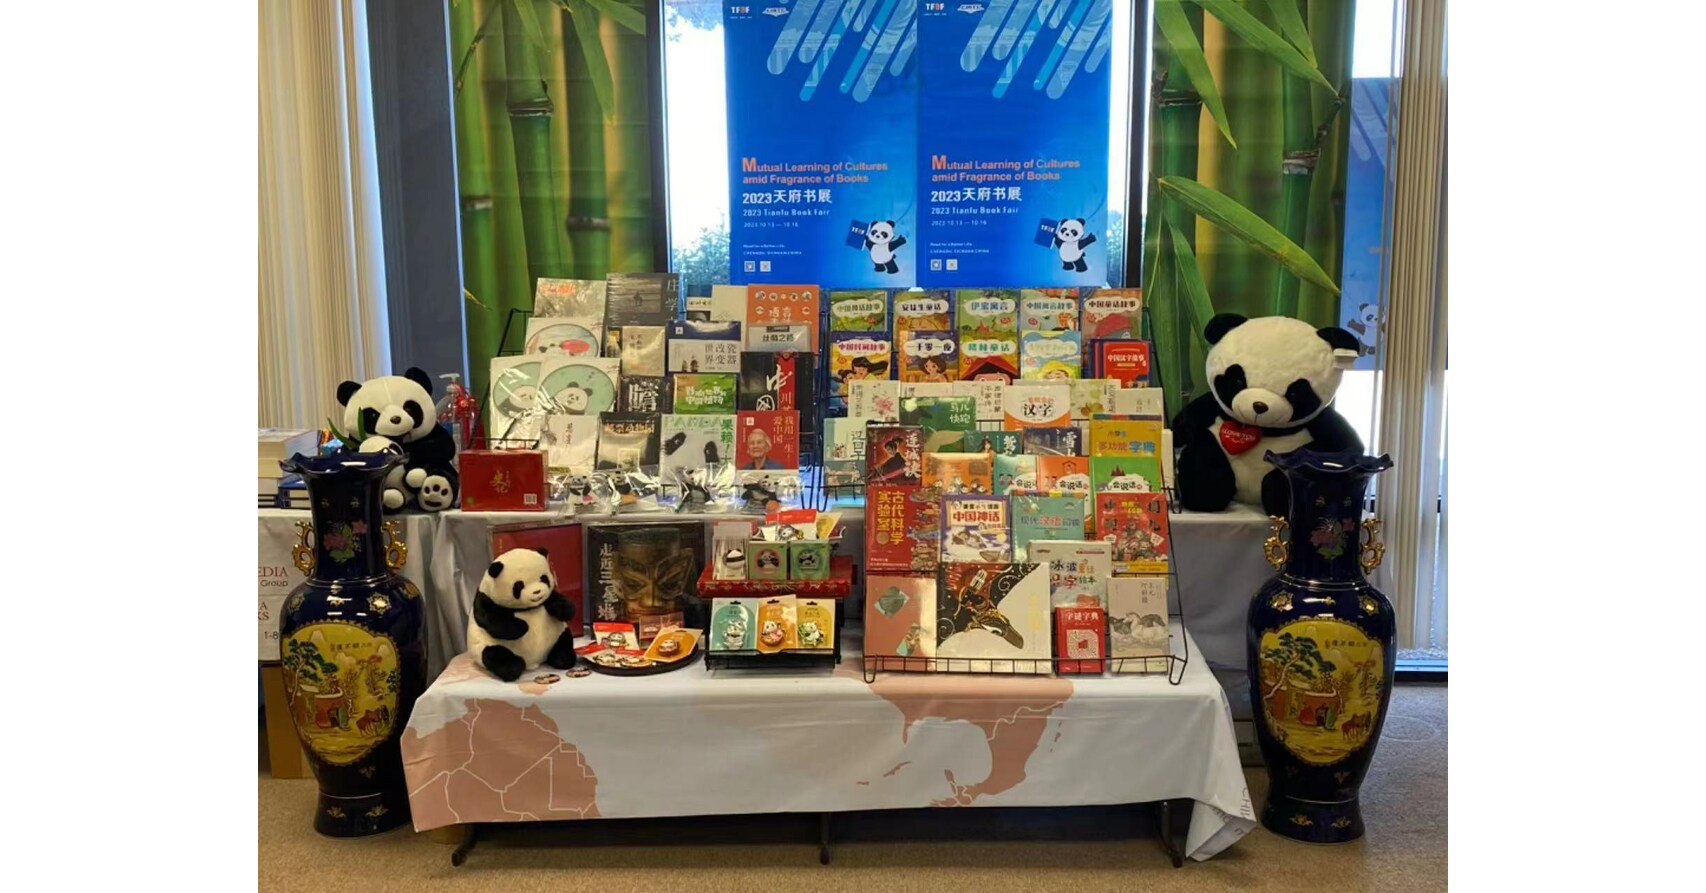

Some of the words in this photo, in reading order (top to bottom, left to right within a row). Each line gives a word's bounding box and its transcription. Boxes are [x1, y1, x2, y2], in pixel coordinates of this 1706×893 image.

[742, 157, 783, 172] Mutual
[785, 162, 830, 174] Learning
[832, 162, 843, 171] of
[845, 162, 888, 170] Cultures
[932, 154, 972, 170] Mutual
[974, 160, 1020, 171] Learning
[1024, 160, 1034, 169] of
[1036, 160, 1080, 168] Cultures
[742, 174, 768, 184] amid
[770, 174, 822, 186] Fragrance
[824, 174, 834, 183] of
[836, 174, 869, 183] Books
[932, 172, 957, 182] amid
[960, 172, 1012, 184] Fragrance
[1014, 172, 1025, 180] of
[1027, 172, 1060, 180] Books
[742, 188, 832, 204] 2023天府书展
[931, 186, 1022, 202] 2023天府书展
[743, 208, 762, 217] 2023
[764, 208, 789, 216] Tianfu
[791, 208, 812, 216] Book
[980, 206, 1000, 214] Book
[1024, 403, 1053, 416] 汉字
[772, 416, 783, 444] 爱中国
[876, 491, 892, 531] 实验室
[890, 491, 905, 545] 古代科学
[953, 511, 1000, 522] 中国神话
[260, 580, 288, 588] Group
[598, 543, 619, 621] 走近三星堆
